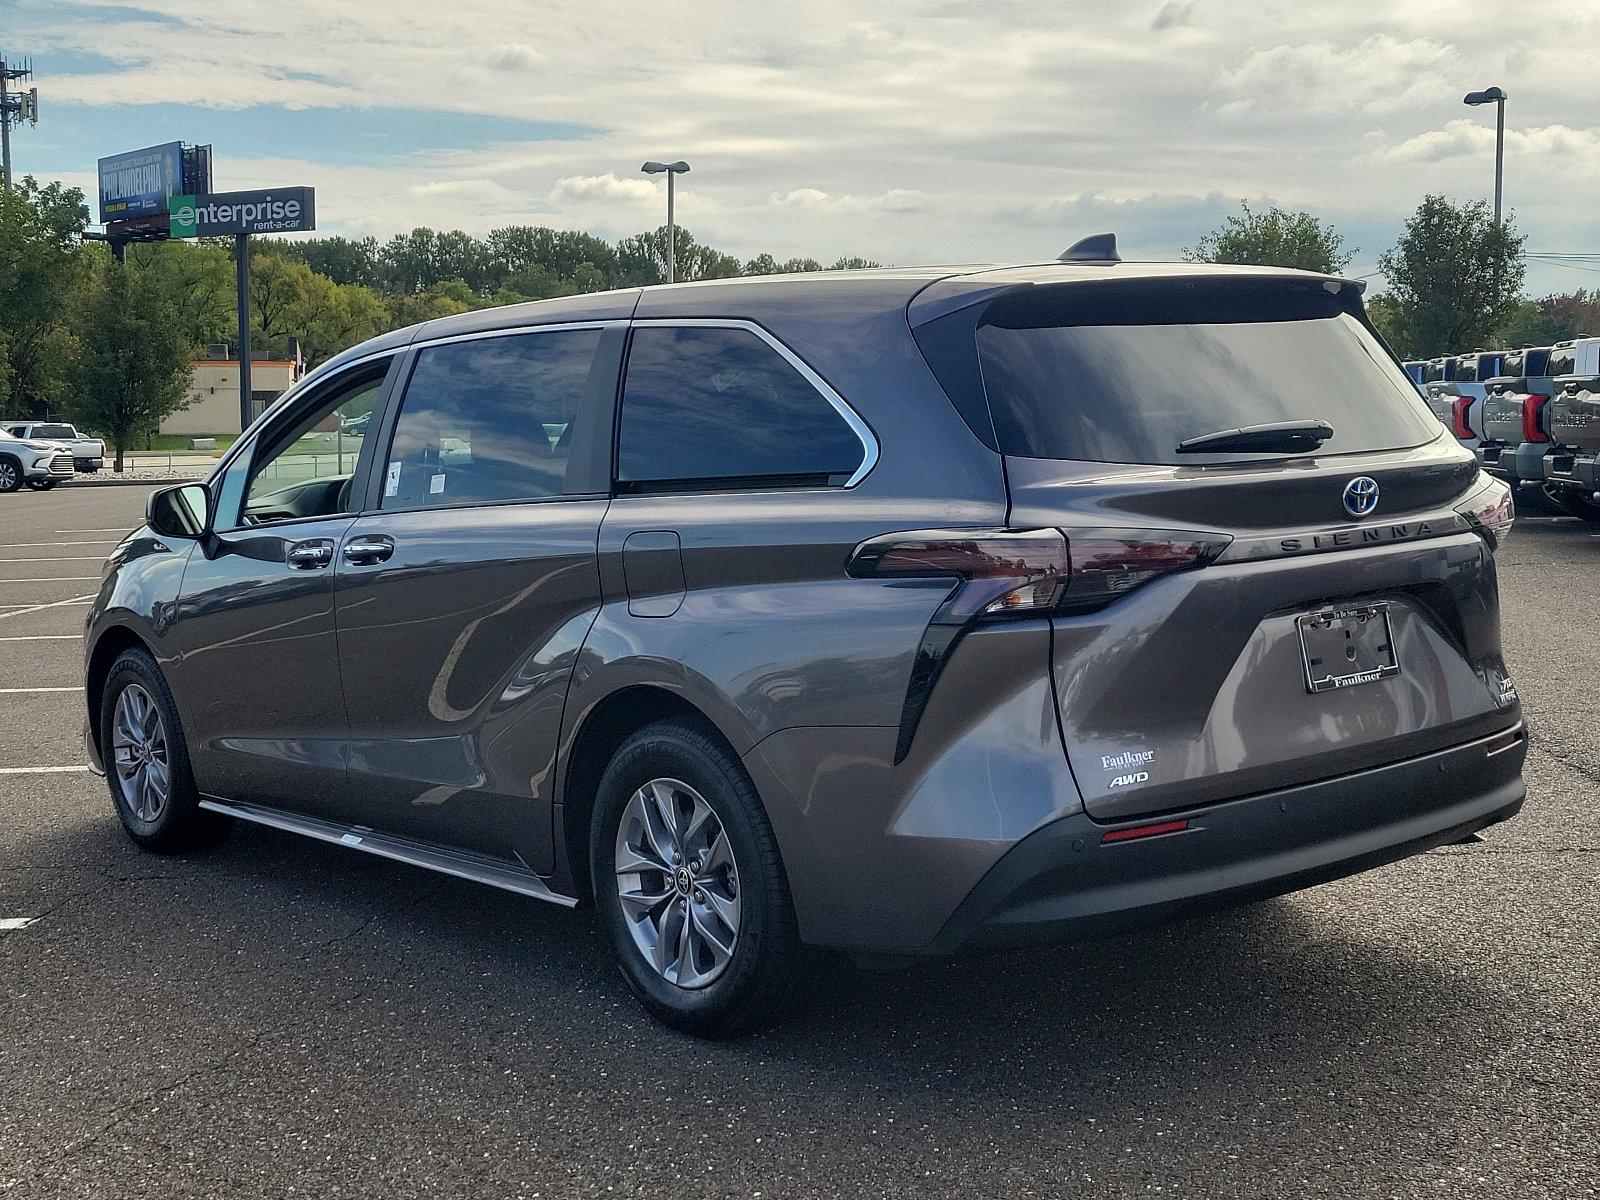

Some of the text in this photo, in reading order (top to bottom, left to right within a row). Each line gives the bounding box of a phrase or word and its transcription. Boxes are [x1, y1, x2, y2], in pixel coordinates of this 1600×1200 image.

[174, 196, 300, 227] enterprise
[253, 219, 300, 230] rent-a-car
[1280, 522, 1431, 552] SIENNA
[1334, 672, 1382, 688] Faulkner
[1101, 750, 1154, 769] Faulkner
[1108, 771, 1149, 788] AWD
